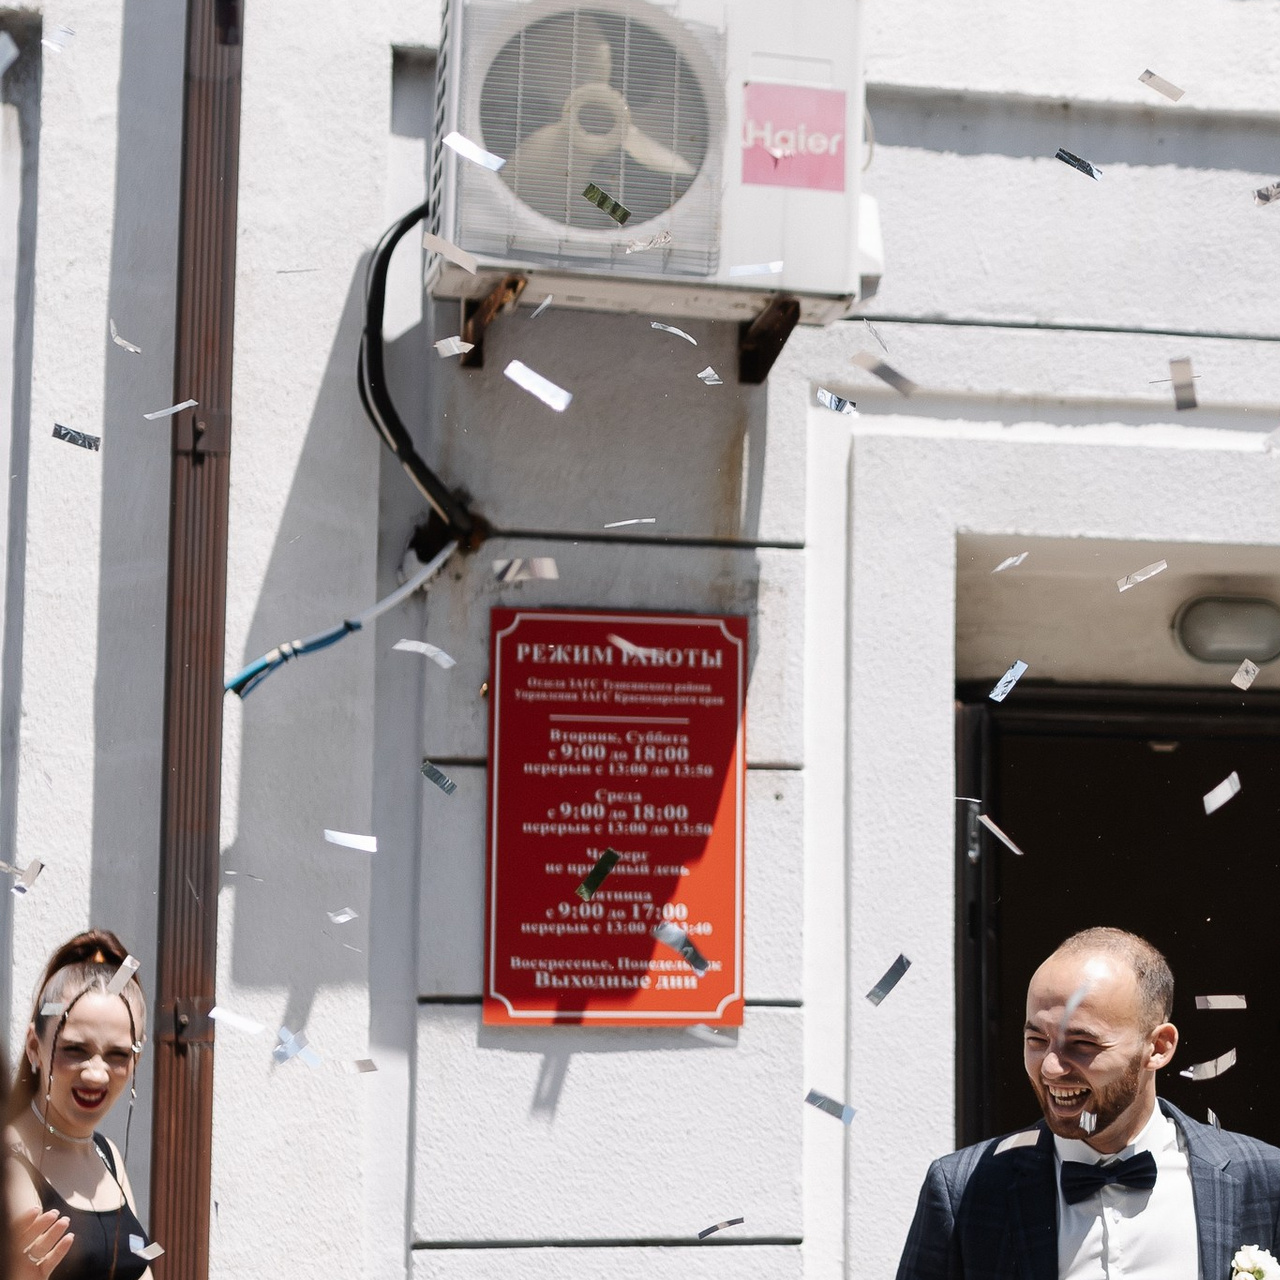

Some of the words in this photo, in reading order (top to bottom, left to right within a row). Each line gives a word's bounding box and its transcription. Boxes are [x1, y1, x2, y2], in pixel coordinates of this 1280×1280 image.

[743, 120, 841, 157] Haier
[516, 642, 613, 666] РЕЖИМ
[621, 647, 724, 669] РАБОТЫ
[550, 728, 622, 745] Вторник,
[625, 729, 689, 746] Суббота
[548, 749, 556, 760] с
[560, 743, 606, 761] 9:00
[609, 749, 629, 762] до
[633, 745, 690, 762] 18:00
[523, 762, 592, 778] перерыв
[595, 764, 604, 775] с
[608, 763, 649, 776] 13:00
[650, 765, 670, 778] до
[594, 788, 643, 805] Среда
[547, 808, 556, 820] с
[559, 802, 606, 820] 9:00
[608, 808, 628, 821] до
[633, 804, 689, 821] 18:00
[522, 821, 591, 837] перерыв
[594, 823, 603, 834] с
[607, 822, 648, 835] 13:00
[650, 824, 669, 836] до
[586, 847, 649, 864] Чверг
[545, 863, 563, 875] не
[653, 865, 691, 877] день
[586, 888, 653, 903] ятница
[545, 907, 554, 919] с
[557, 901, 605, 919] 9:00
[607, 907, 627, 920] до
[631, 902, 689, 921] 17:00
[520, 921, 589, 936] перерыв
[592, 922, 601, 934] с
[606, 921, 647, 935] 13:00
[673, 921, 714, 937] 3:40
[534, 970, 652, 990] Выходные
[655, 973, 698, 991] дни
